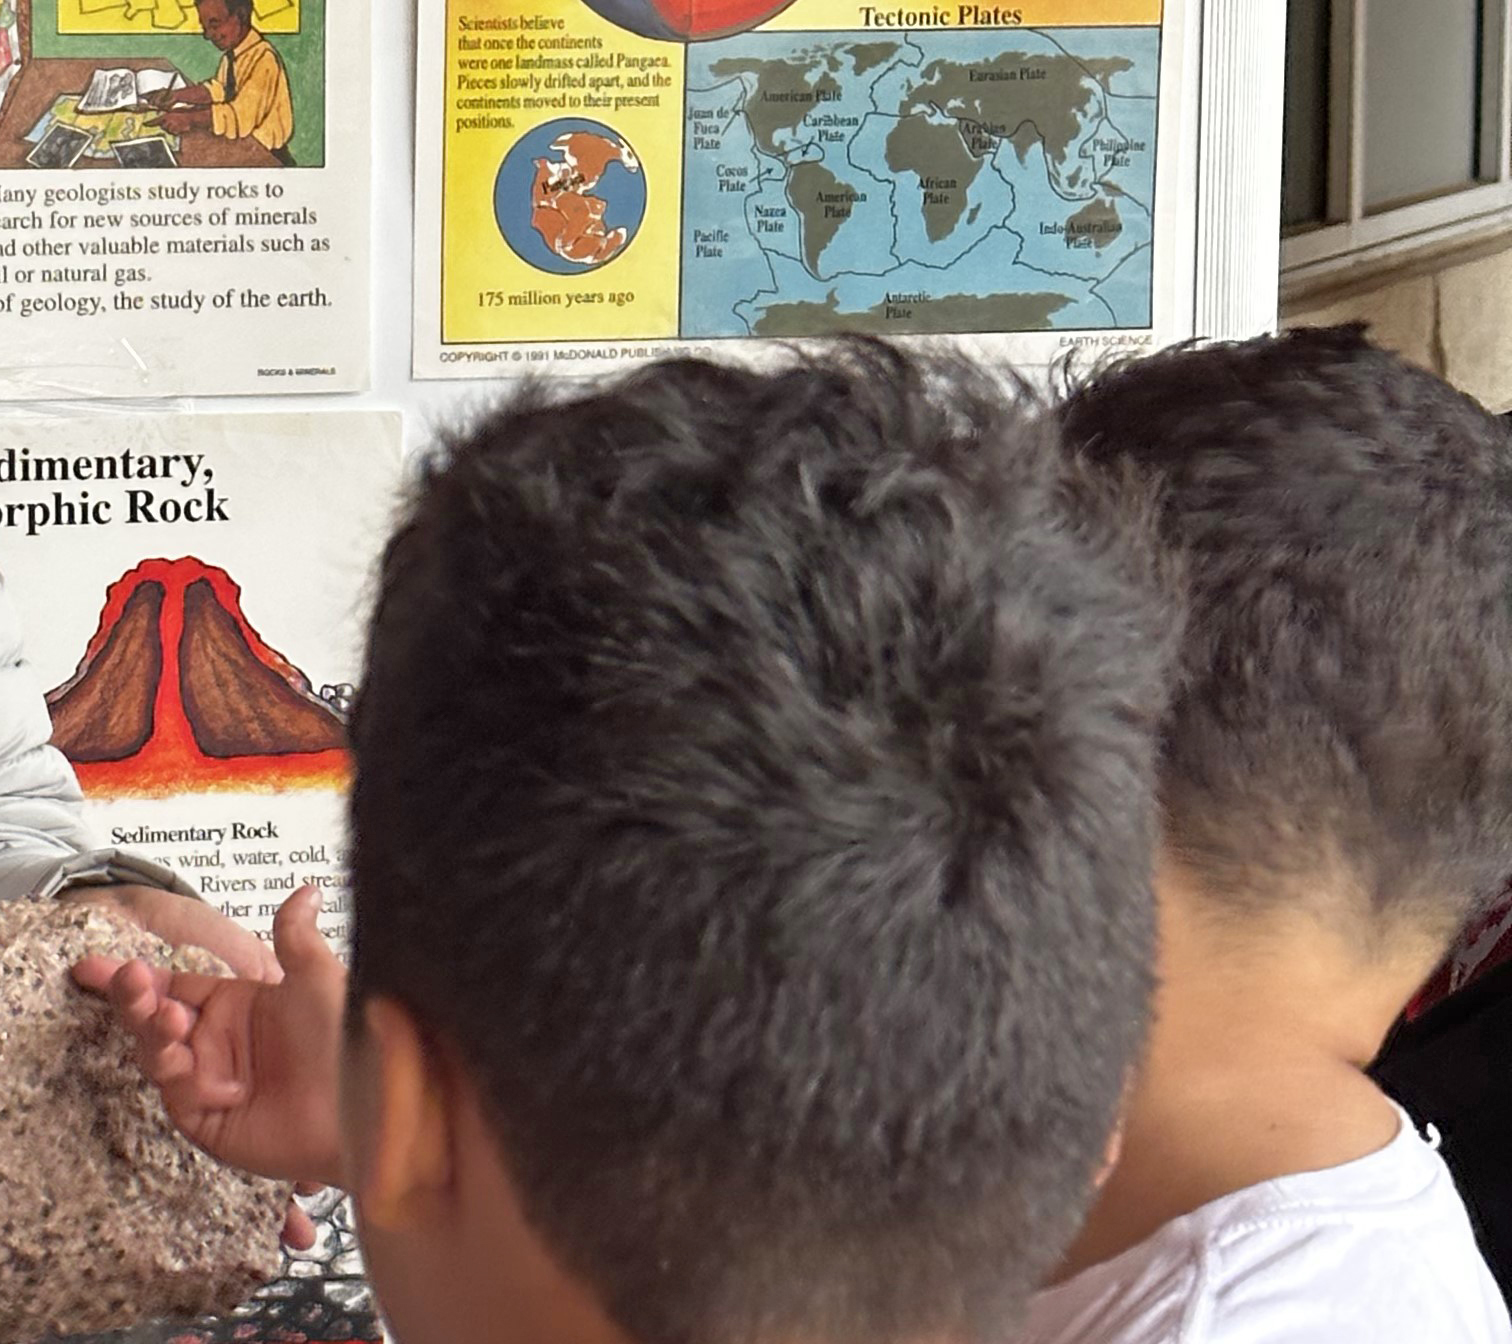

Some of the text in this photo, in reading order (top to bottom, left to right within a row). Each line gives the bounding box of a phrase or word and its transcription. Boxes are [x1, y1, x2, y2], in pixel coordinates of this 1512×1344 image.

[859, 4, 1022, 26] Tectonic Plates
[458, 58, 488, 69] were
[490, 58, 513, 69] one
[516, 55, 573, 69] landmass
[576, 54, 613, 68] called
[969, 68, 1046, 82] Eurasian Plate
[44, 184, 141, 206] geologists
[148, 182, 200, 202] study
[206, 182, 259, 199] rocks
[266, 184, 283, 198] to
[917, 178, 956, 189] African
[924, 192, 949, 204] Plate
[22, 238, 72, 256] other
[79, 237, 160, 254] valuable
[166, 235, 255, 254] materials
[260, 234, 304, 252] such
[310, 237, 330, 251] as
[15, 269, 34, 283] or
[41, 265, 107, 282] natural
[114, 267, 152, 287] gas.
[20, 293, 107, 317] geology,
[113, 292, 143, 309] the
[150, 291, 205, 314] study
[212, 290, 236, 308] of
[240, 290, 271, 307] the
[277, 288, 333, 307] earth.
[478, 291, 635, 308] 175 million years ago
[439, 352, 509, 363] COPYRIGHT
[525, 351, 549, 362] 1991
[125, 488, 229, 523] Rock
[111, 821, 279, 845] Sedimentary Rock
[179, 850, 225, 868] wind,
[233, 850, 283, 866] water,
[289, 846, 330, 864] cold,
[200, 875, 256, 892] Rivers
[264, 873, 295, 889] and
